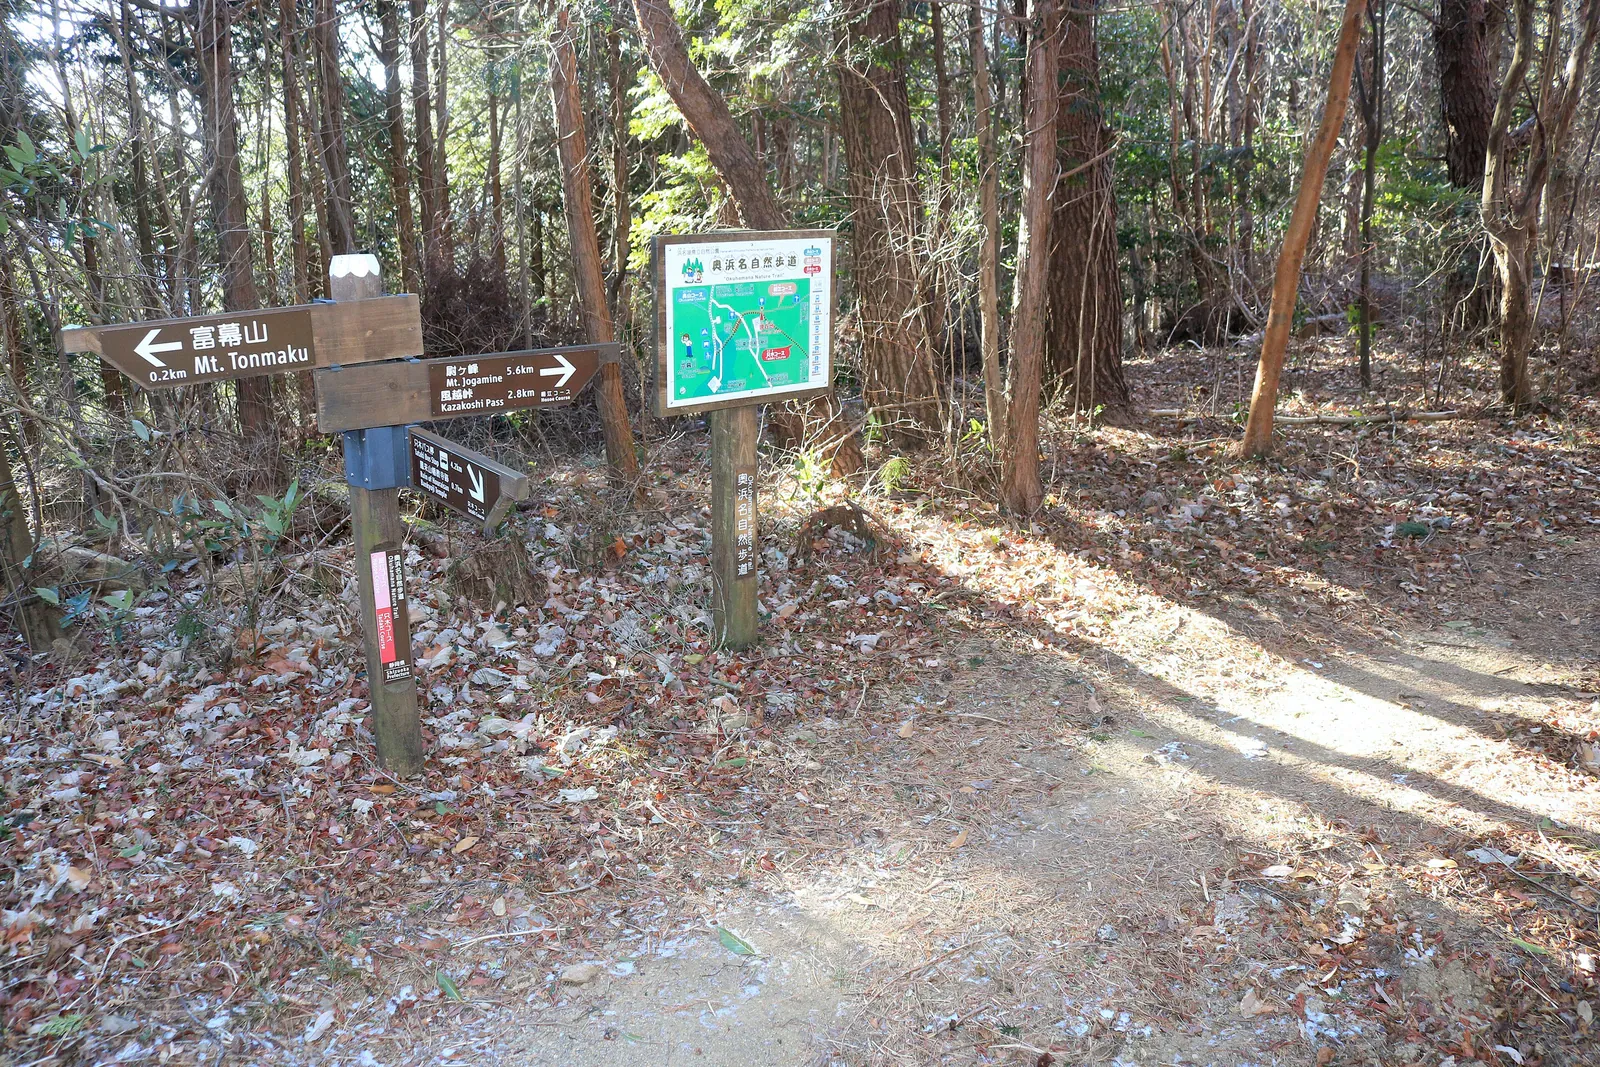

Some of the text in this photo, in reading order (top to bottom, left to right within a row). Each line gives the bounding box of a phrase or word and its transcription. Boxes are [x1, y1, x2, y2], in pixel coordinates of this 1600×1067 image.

[712, 255, 797, 272] 奥浜名自然歩道
[190, 320, 268, 350] 富幕山
[194, 344, 309, 375] Mt. Tonmaku
[150, 368, 187, 382] 0.2km
[506, 365, 534, 376] 5.6km
[446, 374, 503, 387] Mt. Jogamine
[440, 388, 474, 401] 風越峠
[507, 389, 535, 400] 2.8km
[441, 398, 504, 412] Kazakoshi Pass
[738, 473, 748, 576] 奥浜名自然歩道
